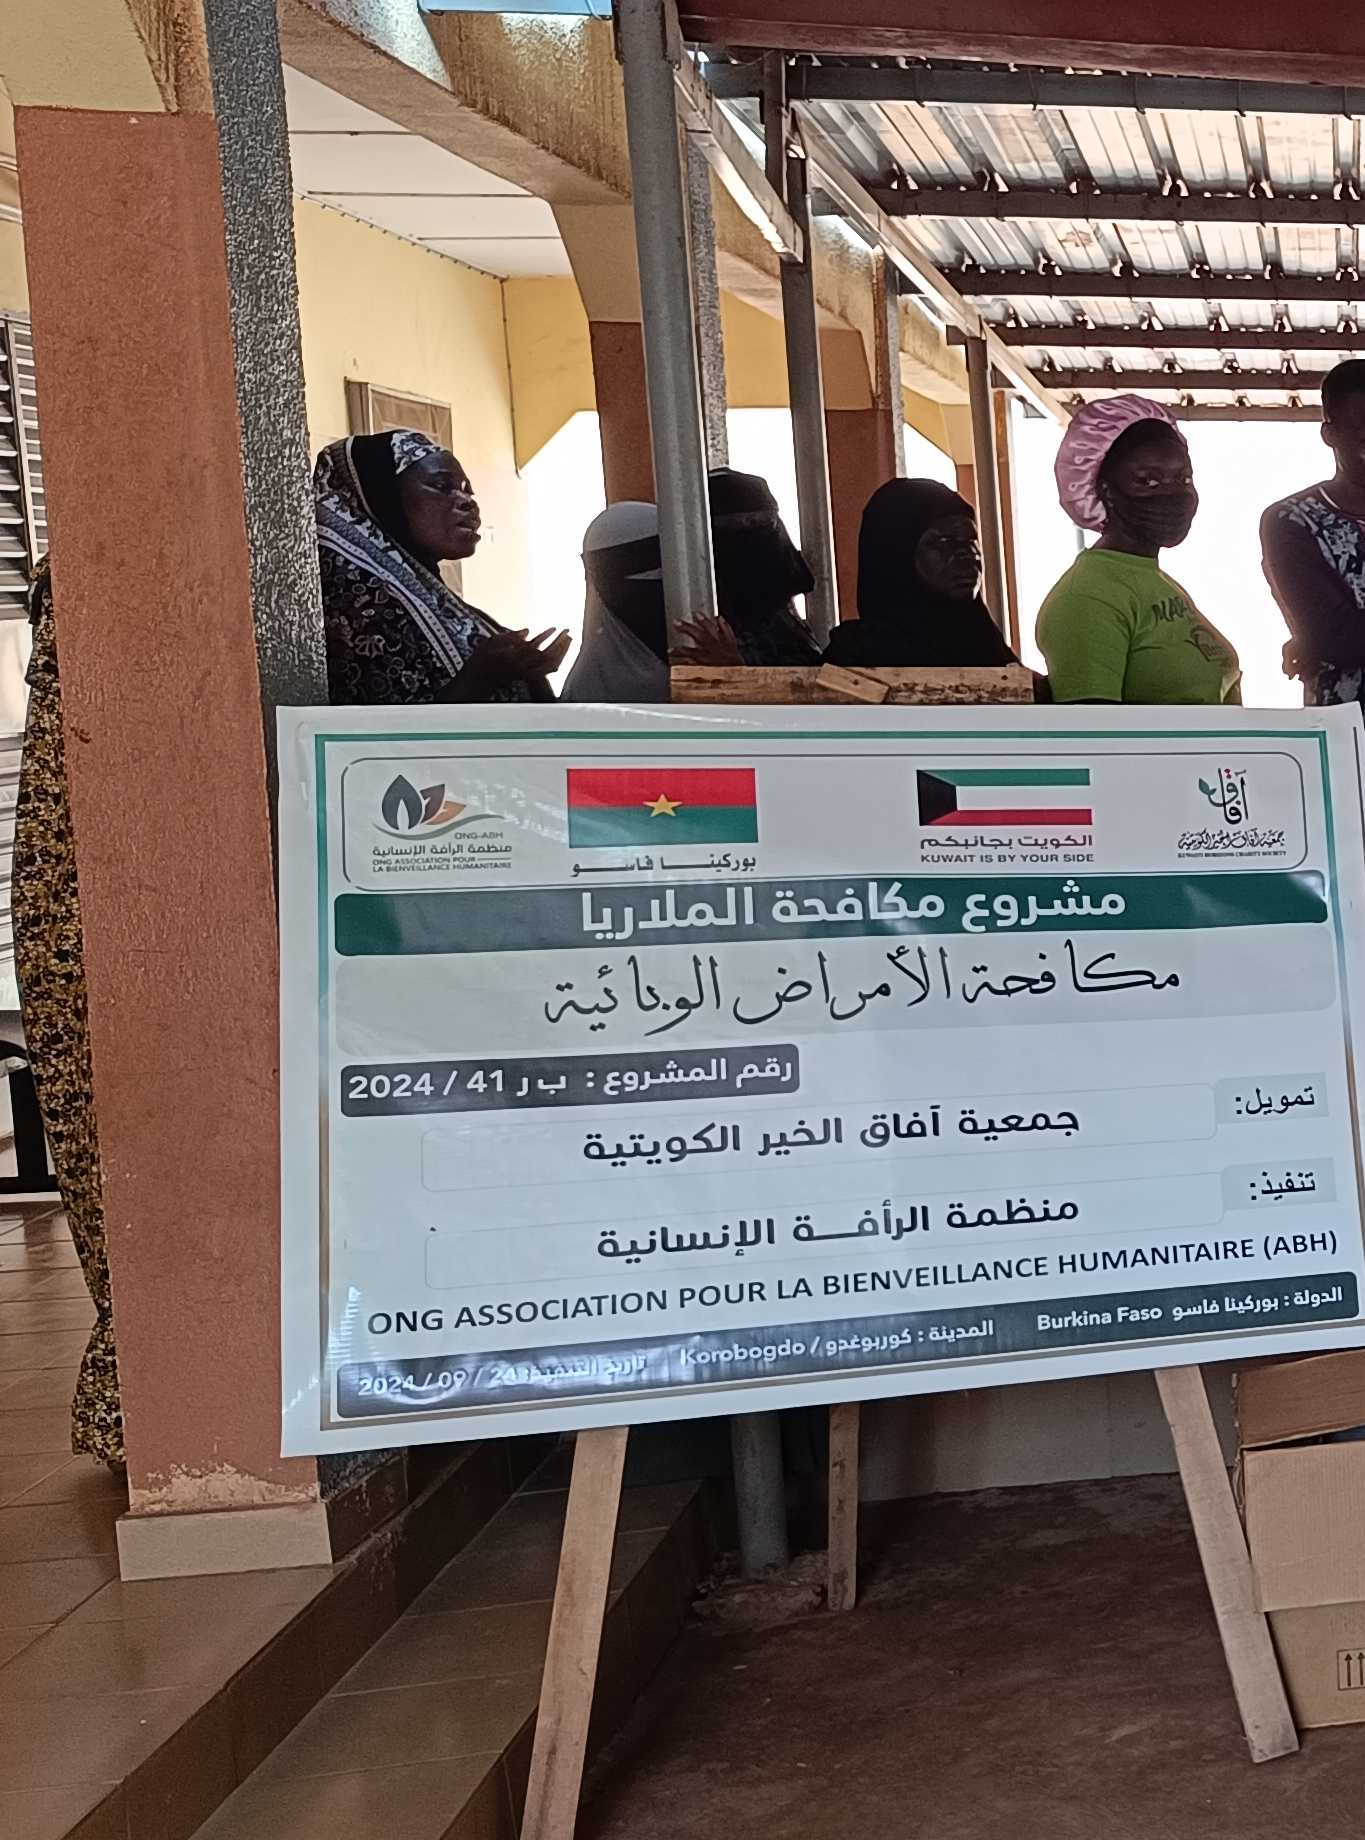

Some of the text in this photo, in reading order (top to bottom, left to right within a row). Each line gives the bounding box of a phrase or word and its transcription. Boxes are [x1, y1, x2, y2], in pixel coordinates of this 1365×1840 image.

[454, 831, 504, 839] ONG-ABH
[920, 834, 1093, 851] الكويت بجانبكم
[372, 842, 512, 857] منظمة الرأفة الإنسانية
[394, 857, 451, 865] ASSOCIATION
[920, 853, 1095, 864] KUWAIT IS BY YOUR SIDE
[386, 864, 450, 872] BIENVEILLANCE
[581, 879, 1126, 940] مشروع مكافحة الملاريا
[545, 938, 1181, 1036] مكافحة الأمراض الوبائية
[442, 1070, 458, 1096] /
[466, 1069, 504, 1093] 41
[603, 1058, 727, 1096] المشروع
[735, 1056, 793, 1088] رقم
[347, 1072, 435, 1099] 2024
[1235, 1086, 1315, 1115] تمويل:
[583, 1105, 1080, 1168] جمعية آفاق الخير الكويتية
[1249, 1171, 1316, 1200] تنفيذ:
[945, 1196, 1080, 1230] منظمة
[596, 1217, 775, 1264] الإنسانية
[367, 1230, 1339, 1336] ONG ASSOCIATION POUR LA BIENVEILLANCE HUMANITAIRE (ABH)
[1224, 1290, 1280, 1315] بوركينا
[1291, 1286, 1344, 1309] الدولة
[1037, 1310, 1112, 1332] Burkina
[1116, 1304, 1163, 1323] Faso
[1172, 1299, 1221, 1322] فاسو
[928, 1319, 995, 1343] المدينة
[680, 1338, 807, 1368] Korobogdo
[358, 1374, 416, 1397] 2024
